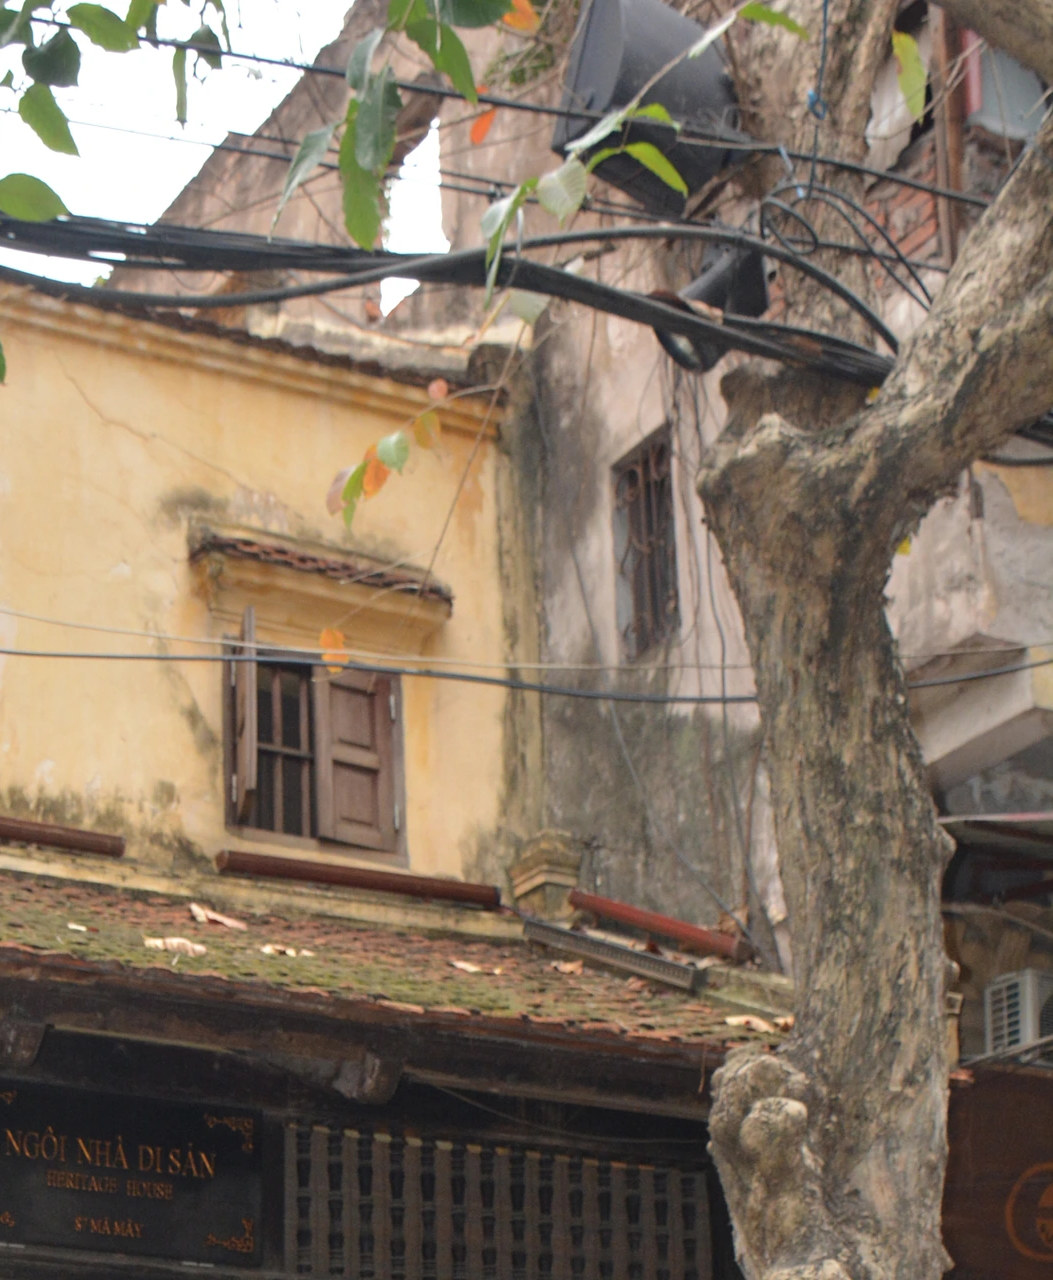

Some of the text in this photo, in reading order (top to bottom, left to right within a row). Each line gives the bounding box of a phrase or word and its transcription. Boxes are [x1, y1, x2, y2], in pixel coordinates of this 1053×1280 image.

[138, 1145, 163, 1174] DI
[46, 1169, 174, 1200] HERITAGE HOUSE
